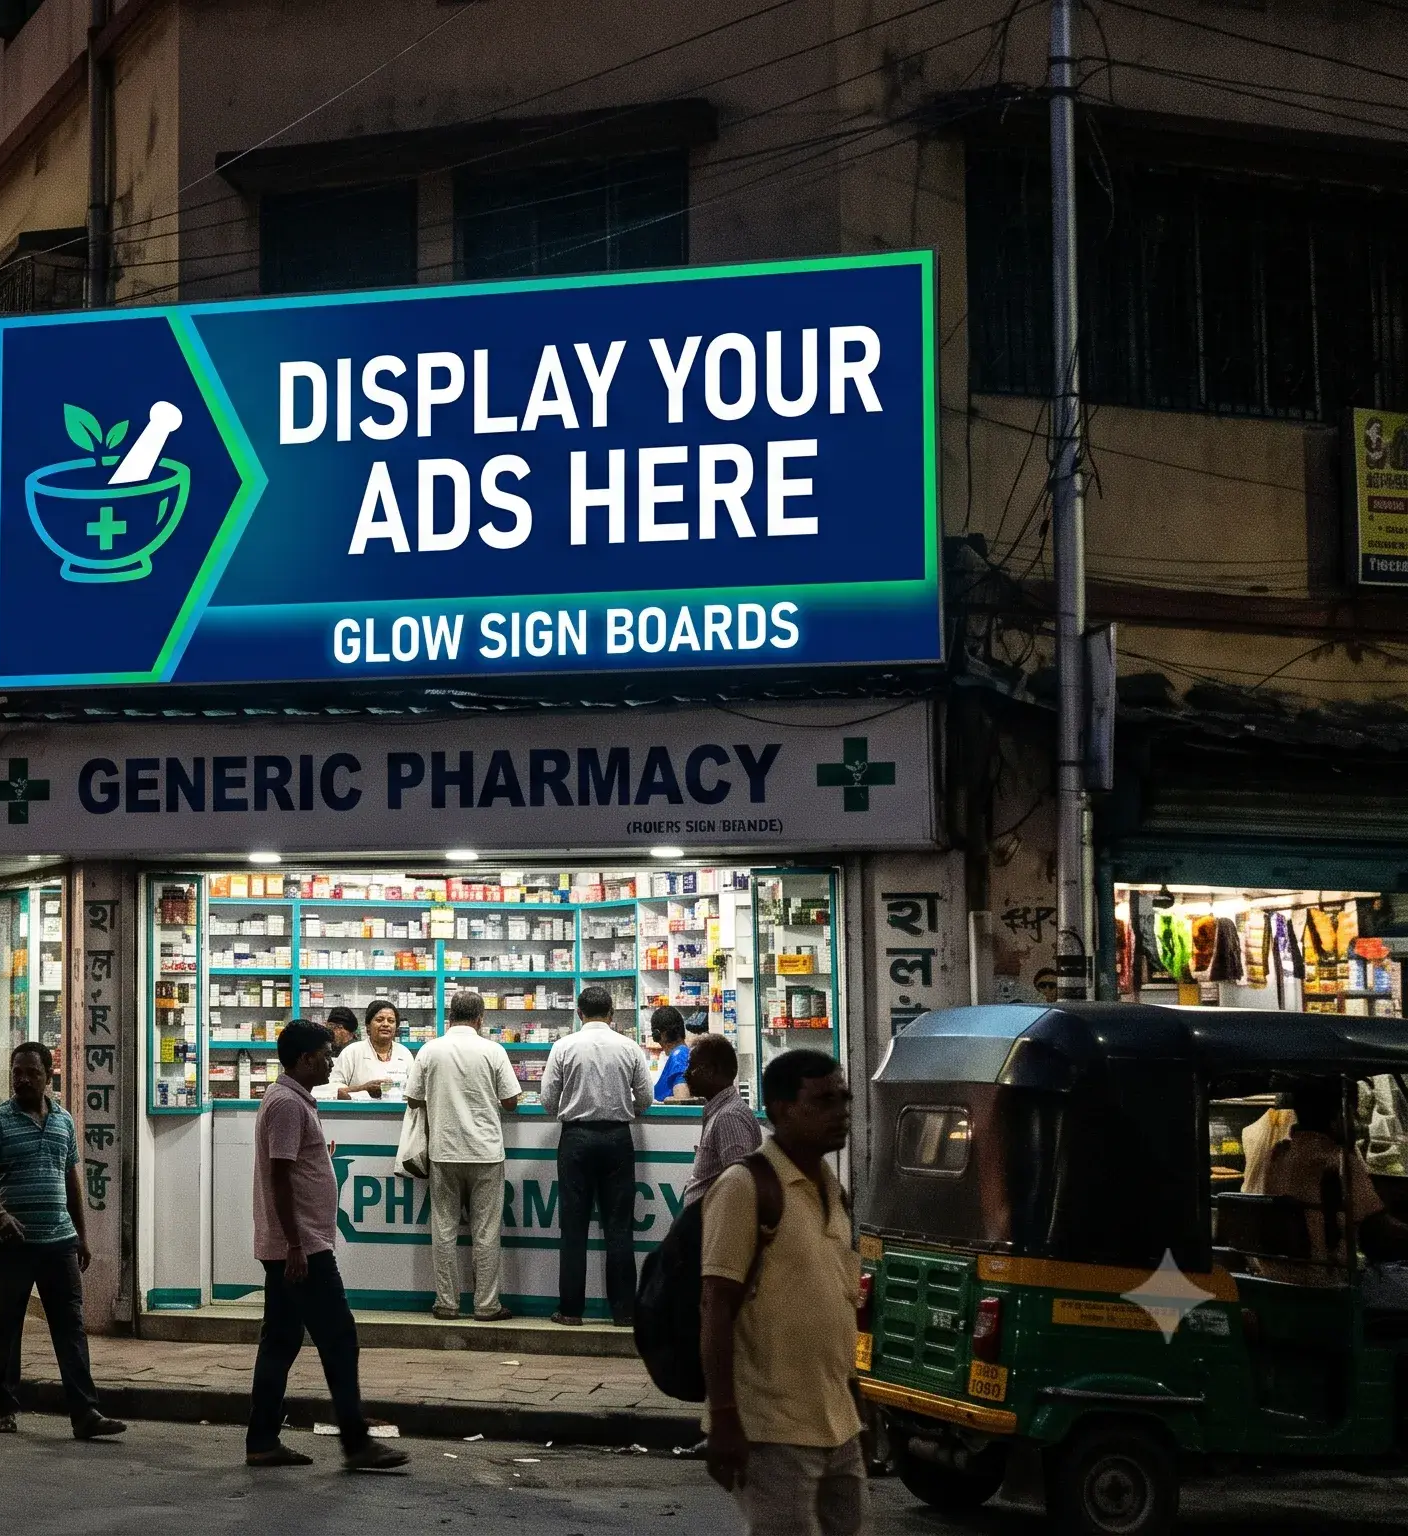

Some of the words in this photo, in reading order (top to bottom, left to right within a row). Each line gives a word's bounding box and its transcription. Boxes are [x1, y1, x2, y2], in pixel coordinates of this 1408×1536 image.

[279, 340, 626, 444] DISPLAY
[649, 325, 882, 423] YOUR
[347, 454, 532, 554] ADS
[570, 438, 819, 545] HERE
[333, 614, 465, 664] GLOW
[479, 608, 587, 660] SIGN
[606, 601, 799, 654] BOARDS
[78, 752, 363, 815] GENERIC
[387, 743, 783, 810] PHARMACY
[685, 819, 716, 833] SIGN
[353, 1175, 688, 1232] PHMCY
